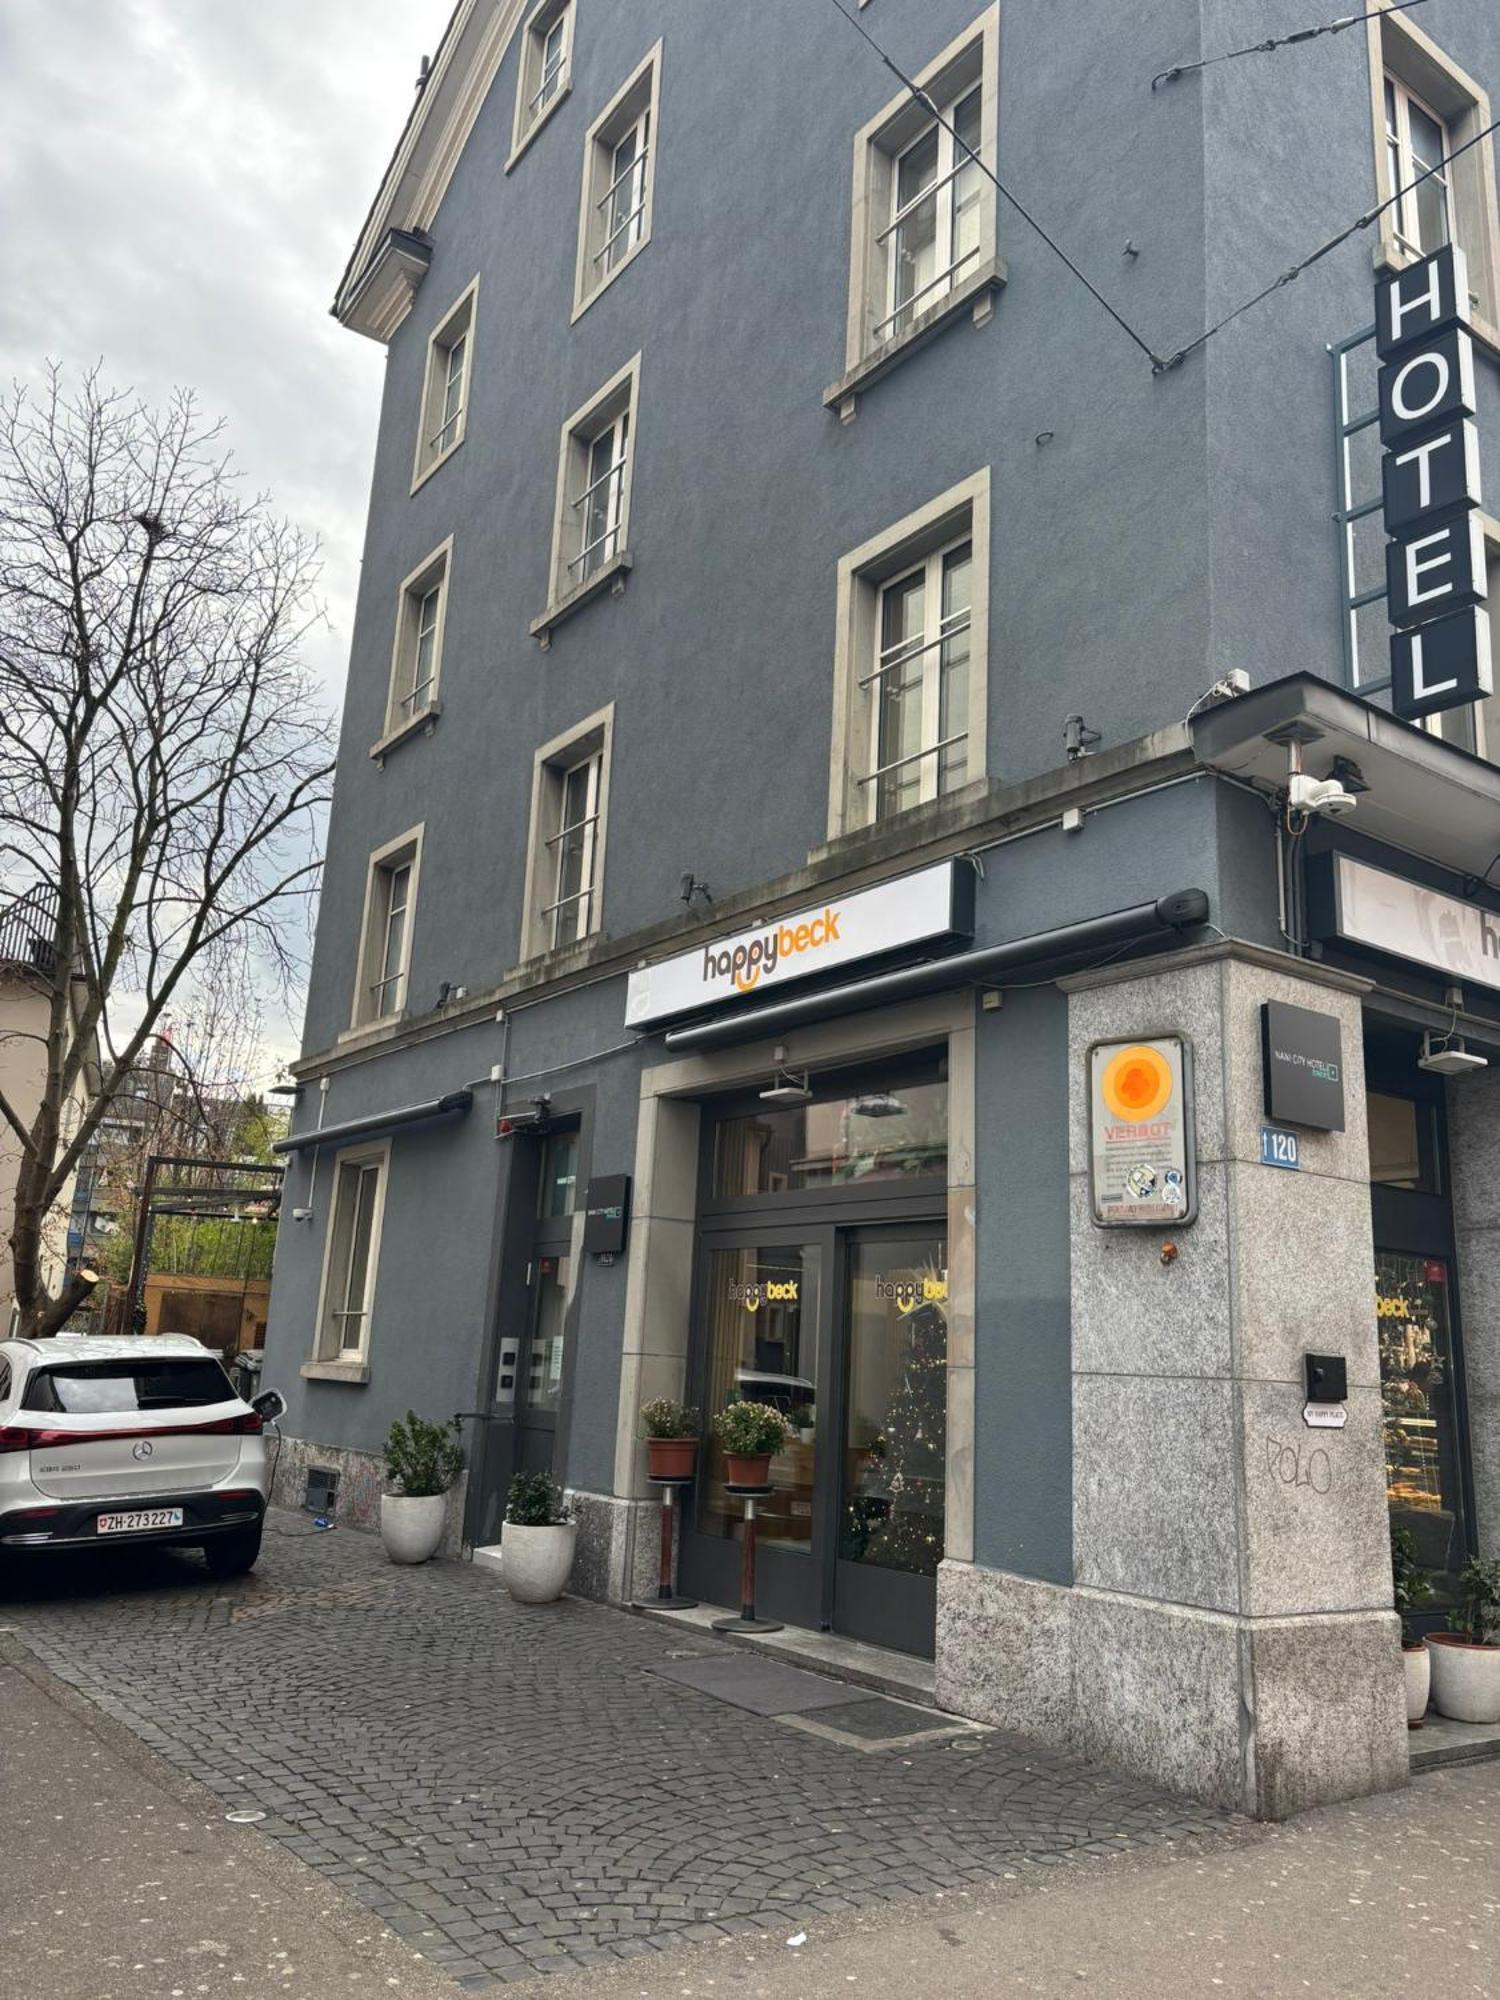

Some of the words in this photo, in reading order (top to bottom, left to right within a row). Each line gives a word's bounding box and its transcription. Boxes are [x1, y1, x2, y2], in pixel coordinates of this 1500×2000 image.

[1390, 260, 1458, 701] HOTEL
[703, 905, 841, 985] happybeck
[1271, 1133, 1297, 1162] 120
